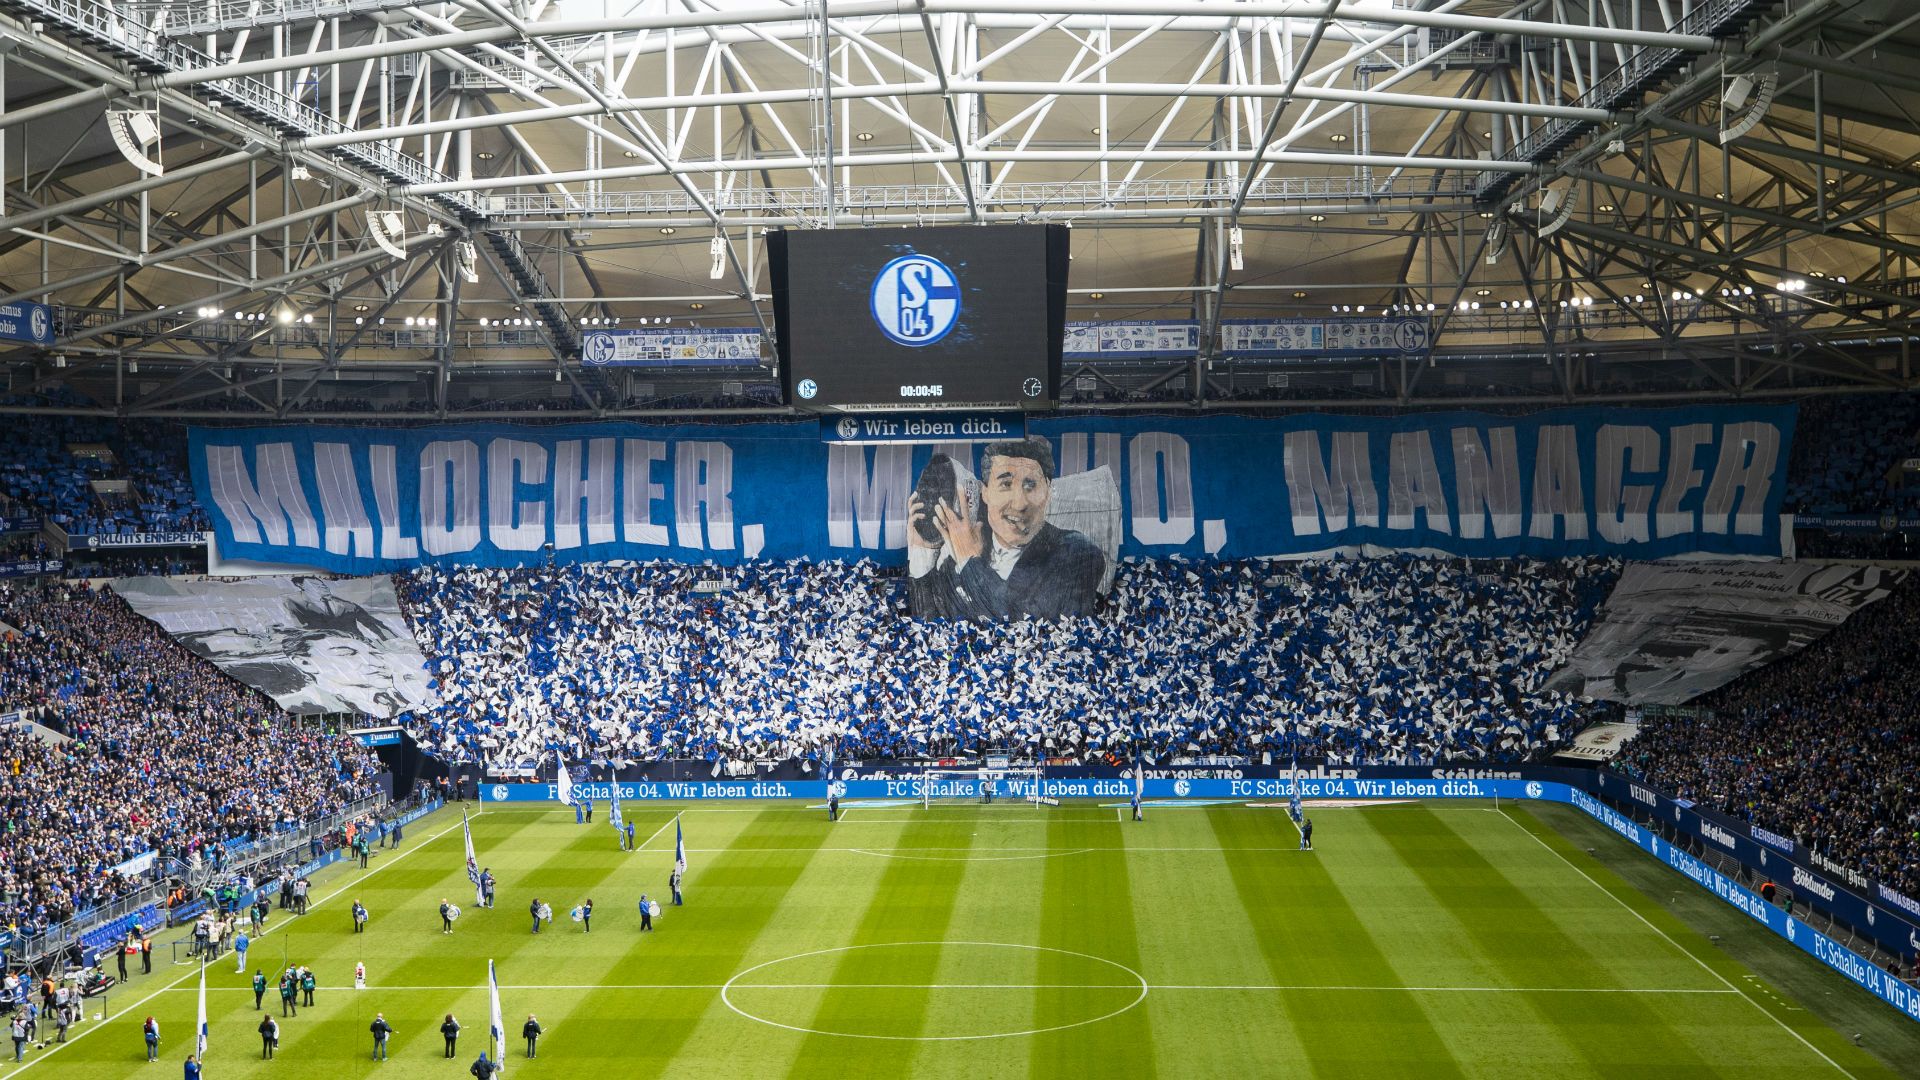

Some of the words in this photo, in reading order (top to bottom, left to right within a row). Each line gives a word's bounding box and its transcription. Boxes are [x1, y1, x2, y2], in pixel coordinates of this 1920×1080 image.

[900, 384, 943, 397] 00:00:45
[863, 419, 898, 436] Wir
[904, 418, 959, 435] leben
[961, 417, 1008, 434] dich.
[205, 436, 765, 560] MALOCHER.
[1283, 421, 1781, 545] MANAGER
[1825, 519, 1877, 527] SUPPORTERS
[144, 532, 206, 544] ENNEPETAL
[370, 732, 394, 741] Tunnel
[1431, 767, 1522, 780] Stölting
[638, 783, 662, 799] 04.
[666, 783, 698, 799] Wir
[701, 782, 747, 798] leben
[750, 782, 792, 798] dich.
[886, 781, 907, 796] FC
[911, 781, 977, 796] Schalke
[1006, 780, 1038, 796] Wir
[1042, 780, 1089, 796] leben
[1092, 780, 1134, 796] dich.
[1231, 780, 1252, 796] FC
[1256, 780, 1321, 796] Schake
[1325, 780, 1349, 796] 04.
[1353, 780, 1386, 796] Wir
[1390, 780, 1438, 796] leben
[1441, 780, 1485, 797] dich.
[1629, 783, 1657, 807] VELTINS
[1612, 811, 1627, 836] leben
[1700, 819, 1736, 850] bet-at-home
[1750, 825, 1790, 850] FLENSBURG
[1669, 847, 1680, 868] FC
[1679, 852, 1703, 882] Schalke
[1703, 867, 1714, 890] 04.
[1714, 872, 1728, 898] Wir
[1728, 881, 1749, 912] leben
[1749, 895, 1769, 925] dich.
[1793, 865, 1835, 902] Böklunder
[1814, 933, 1827, 960] FC
[1828, 941, 1865, 984] Schalke
[1866, 965, 1883, 995] 04.
[1883, 974, 1905, 1009] Wir
